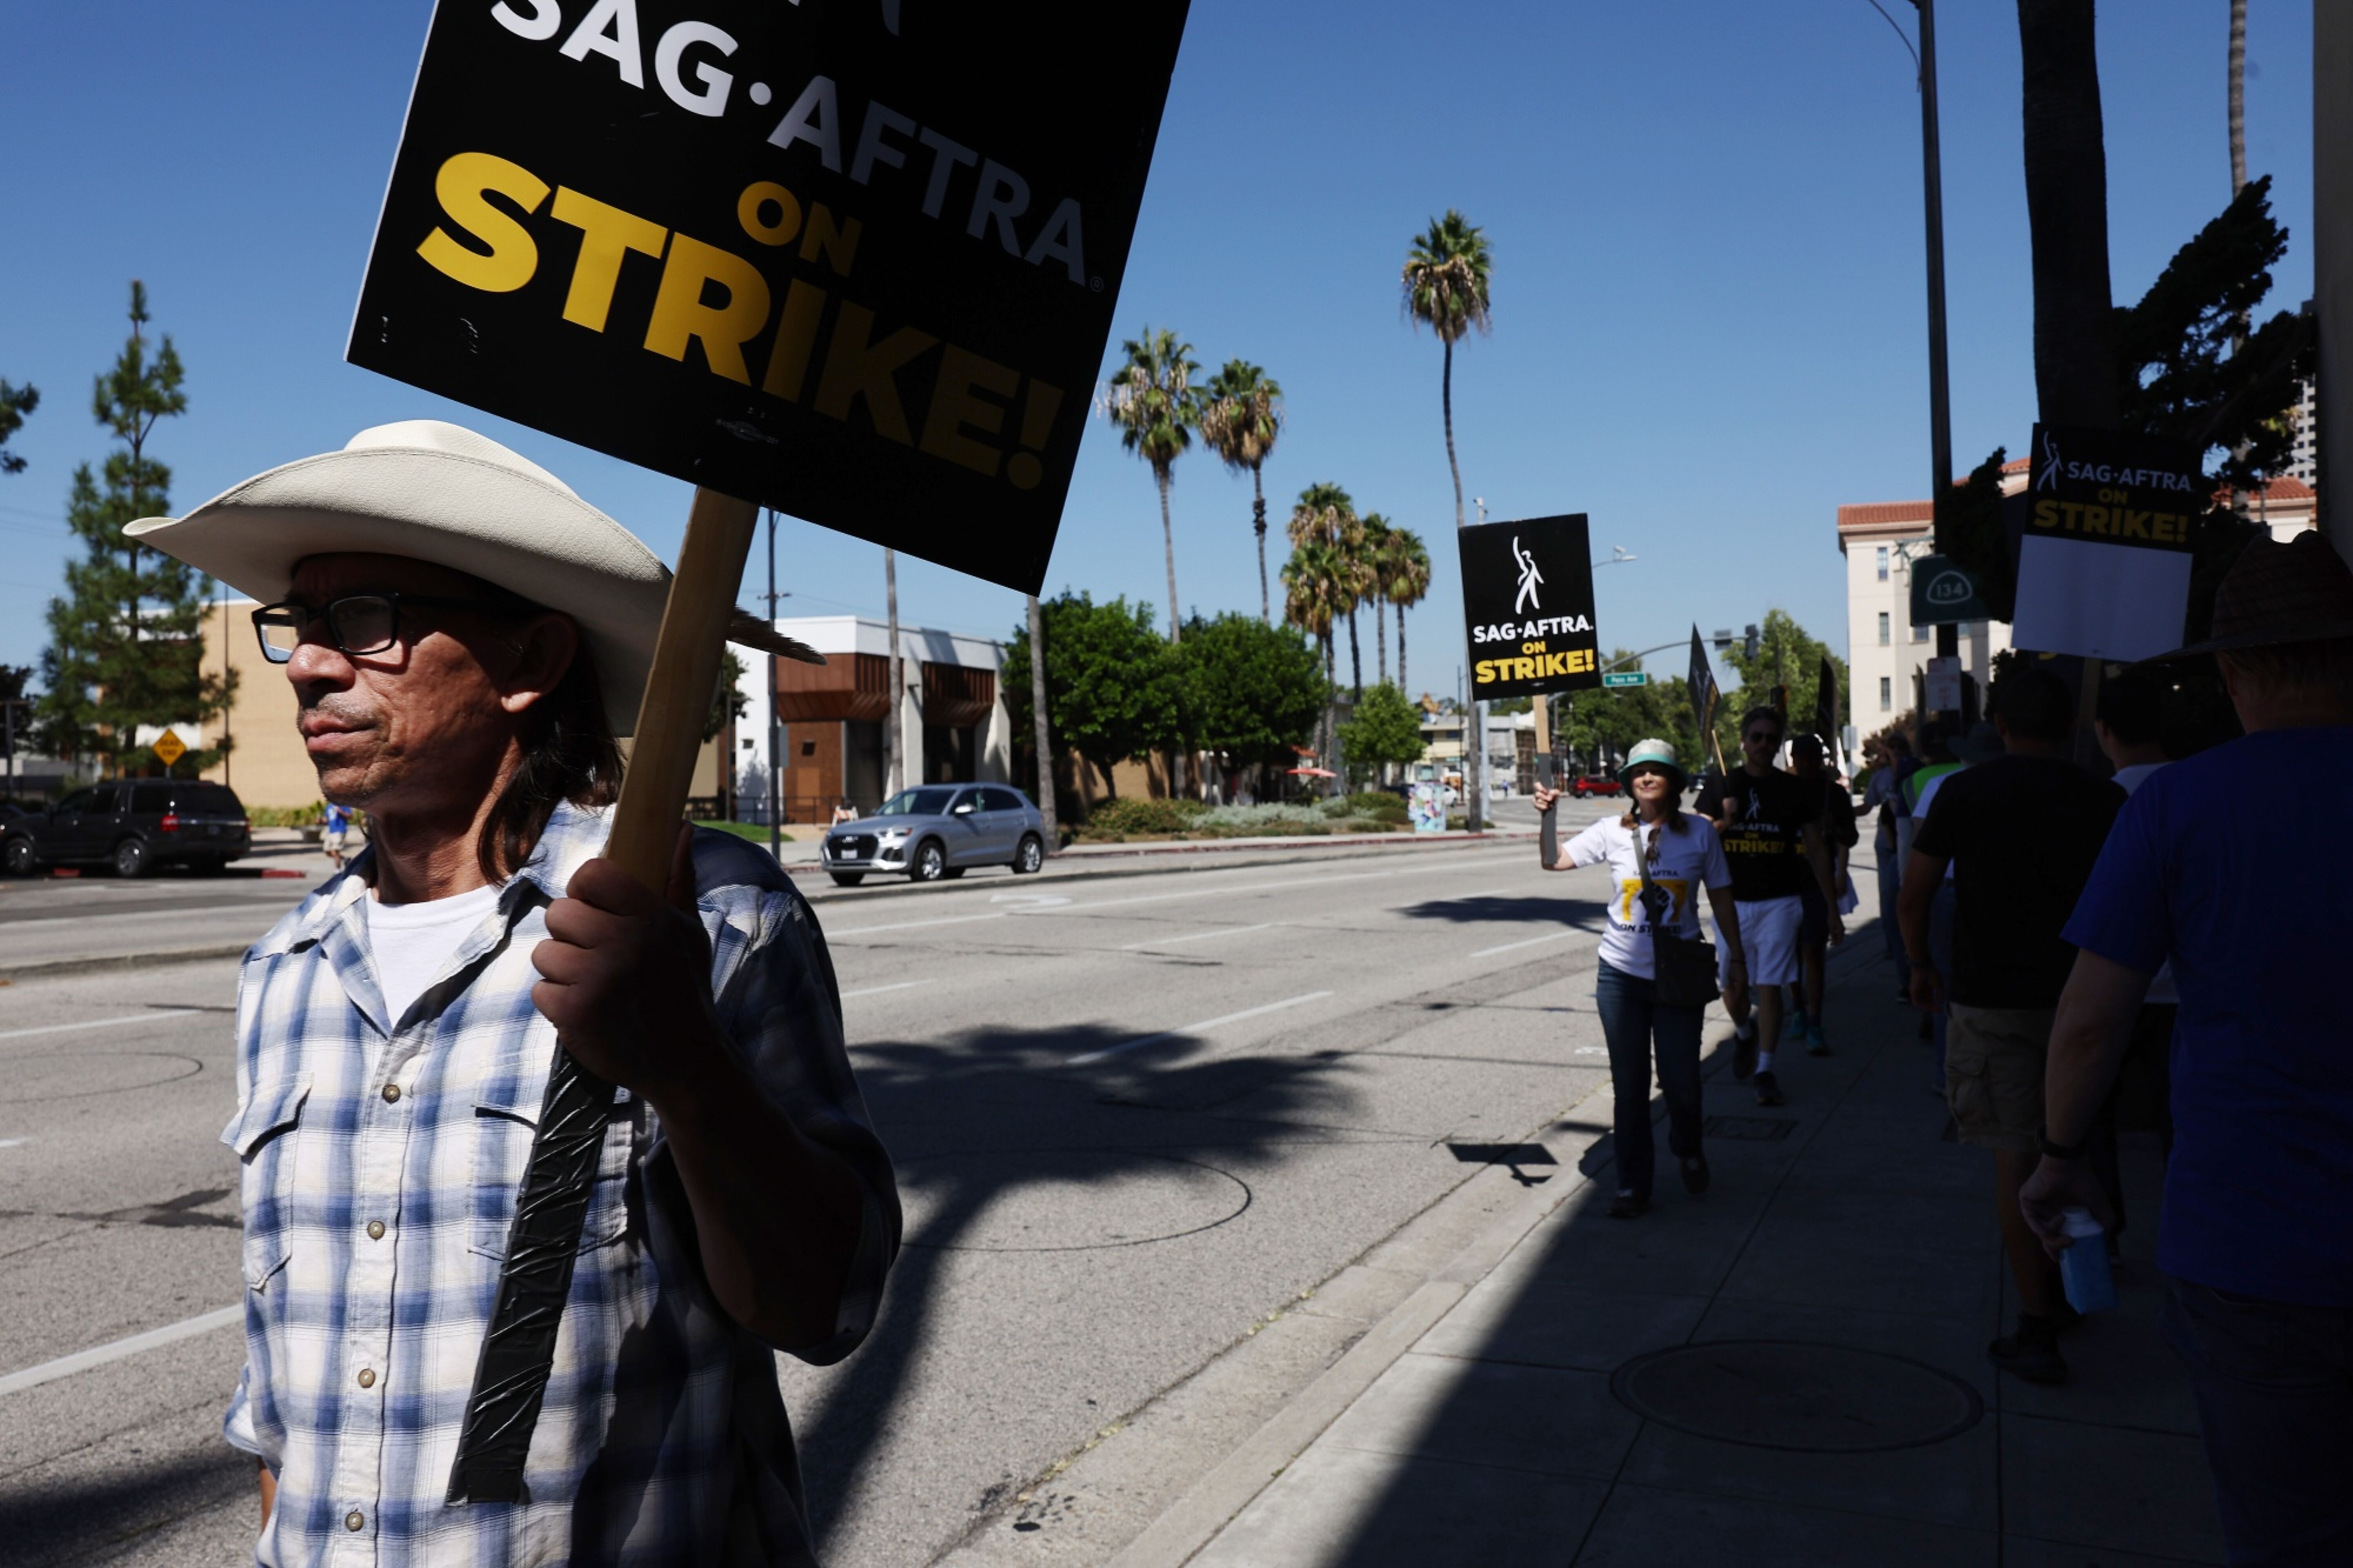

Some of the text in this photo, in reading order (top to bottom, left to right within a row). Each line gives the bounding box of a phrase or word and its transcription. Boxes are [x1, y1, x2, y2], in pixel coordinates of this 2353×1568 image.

[737, 181, 861, 275] ON
[416, 151, 1064, 491] STRIKE!
[2097, 487, 2128, 505] ON
[2033, 498, 2189, 543] STRIKE!
[1937, 582, 1964, 598] 134
[1522, 641, 1546, 654] ON
[1475, 649, 1595, 683] STRIKE!
[1620, 924, 1636, 932] ON
